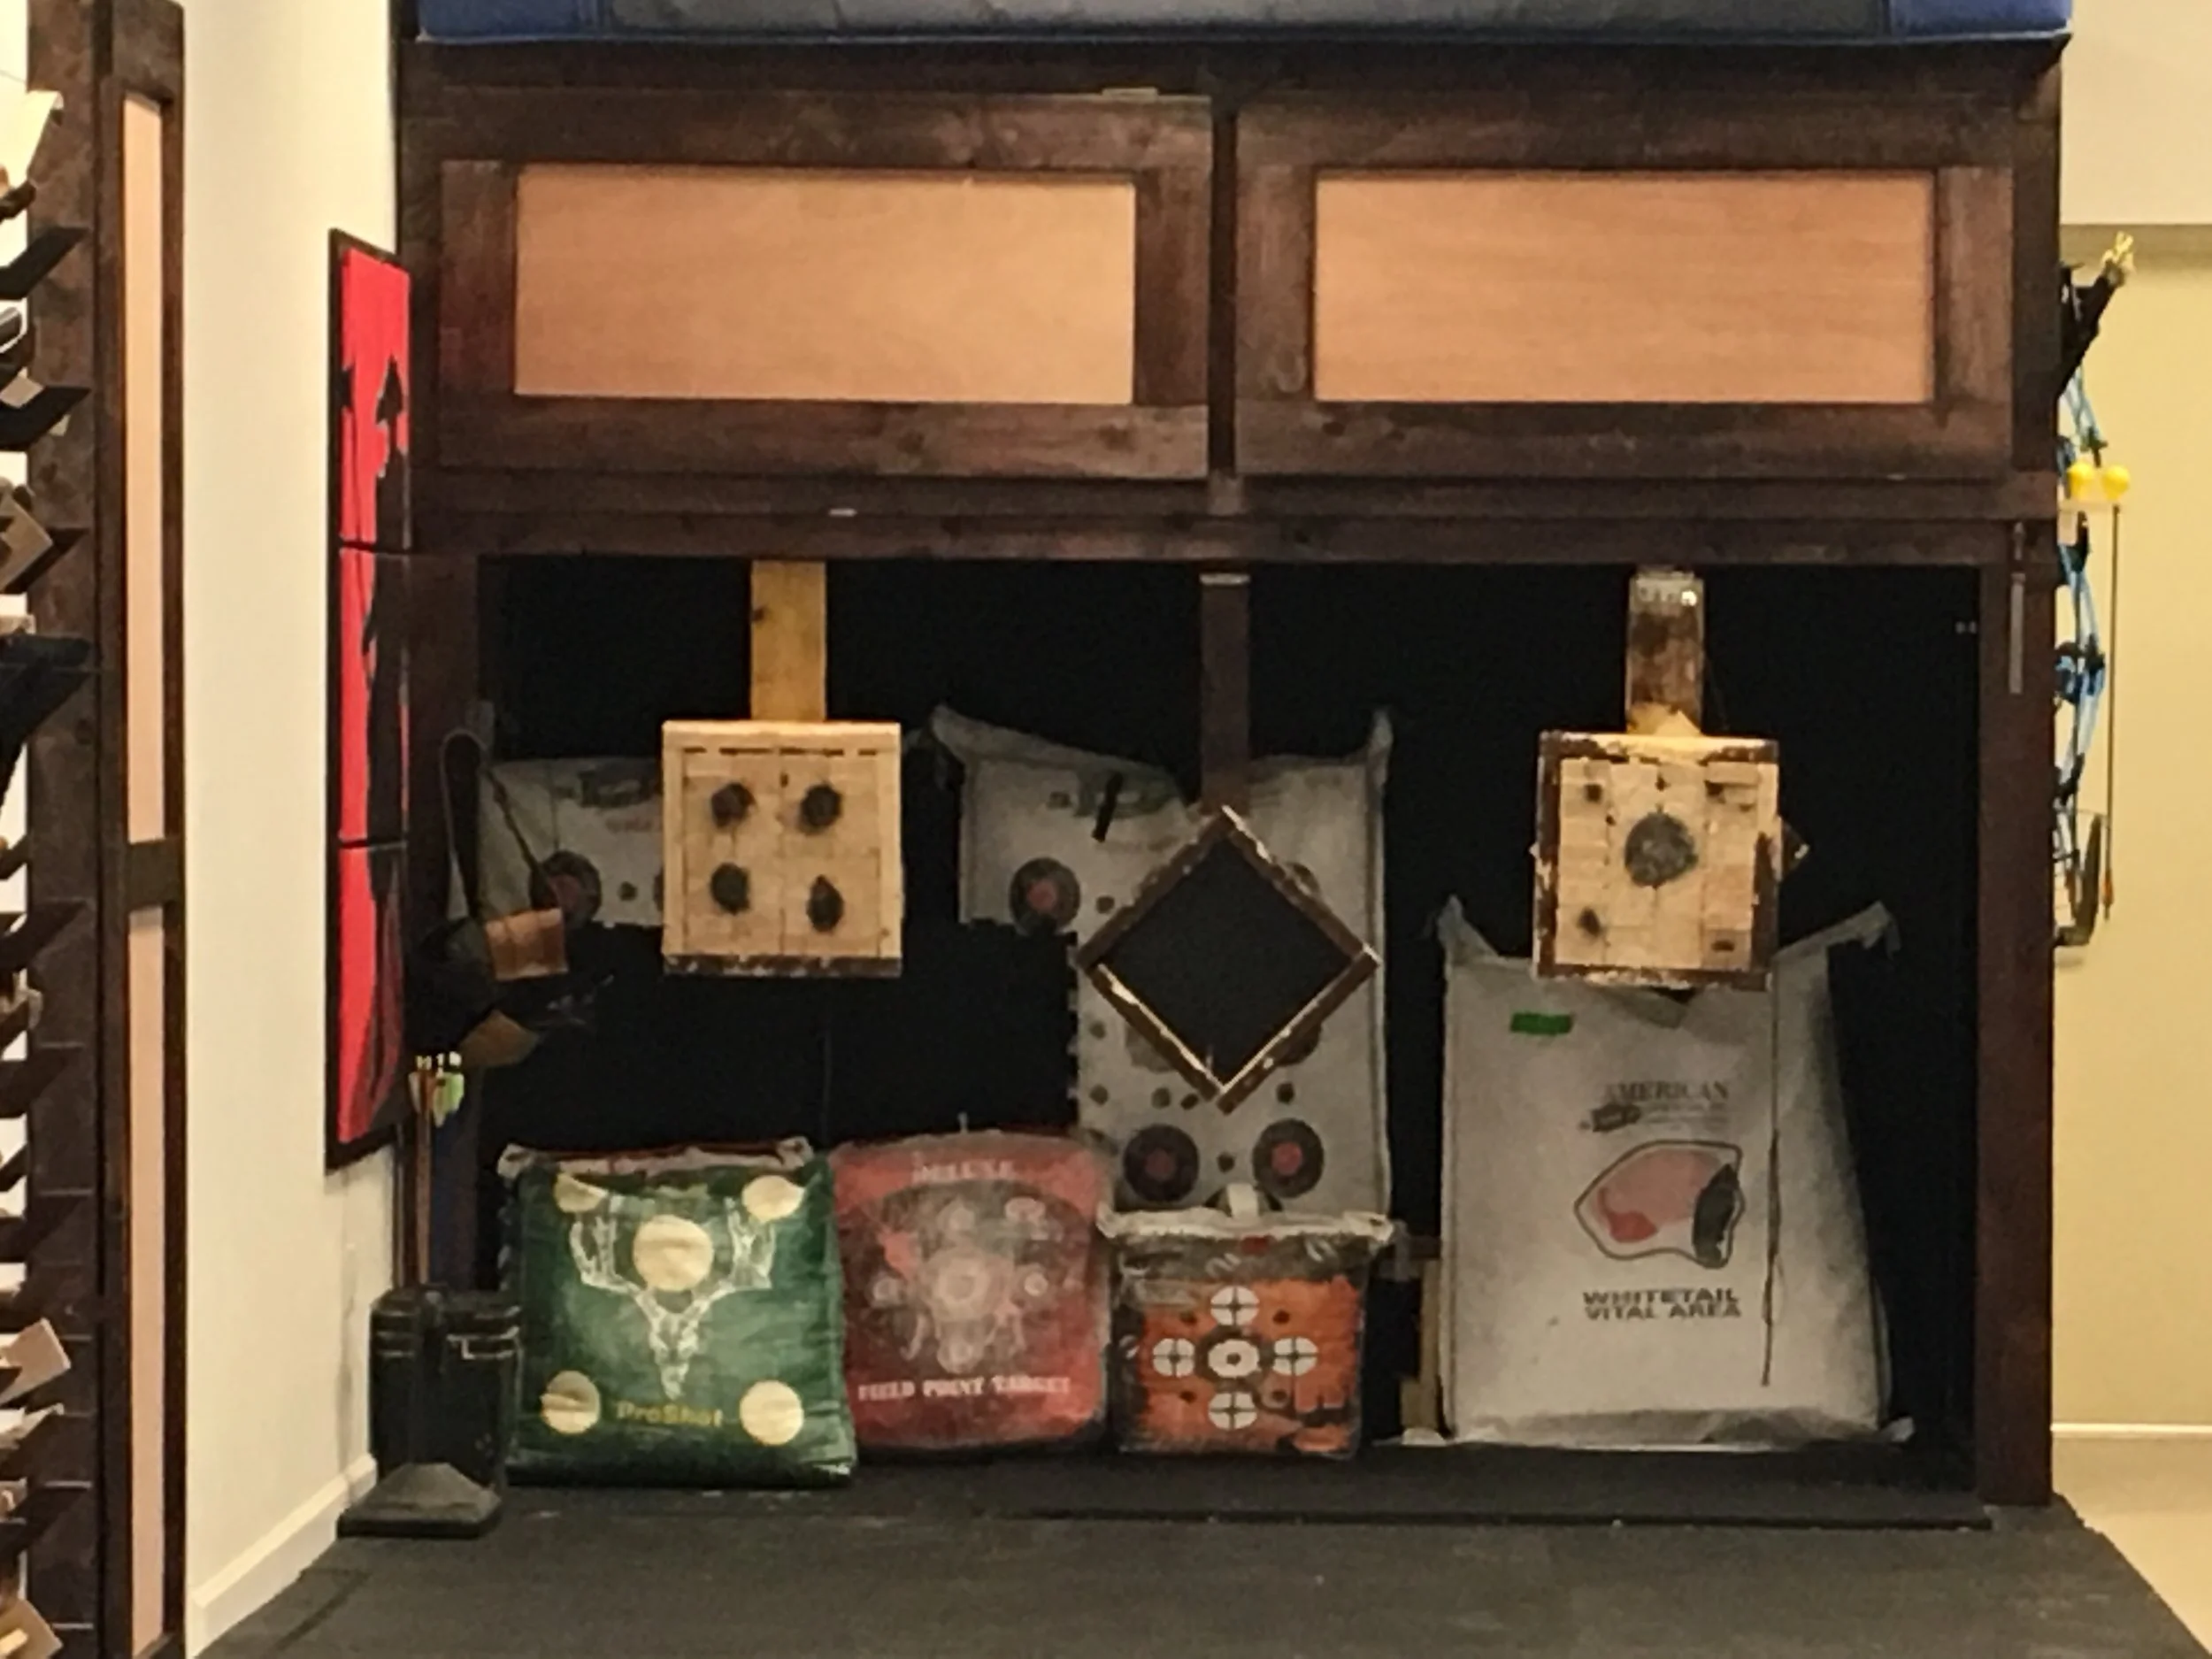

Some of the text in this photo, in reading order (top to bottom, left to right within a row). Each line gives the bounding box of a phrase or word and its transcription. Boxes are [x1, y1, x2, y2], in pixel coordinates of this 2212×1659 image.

[1582, 1288, 1740, 1305] WHITETAIL
[1584, 1303, 1742, 1320] VITAL AREA
